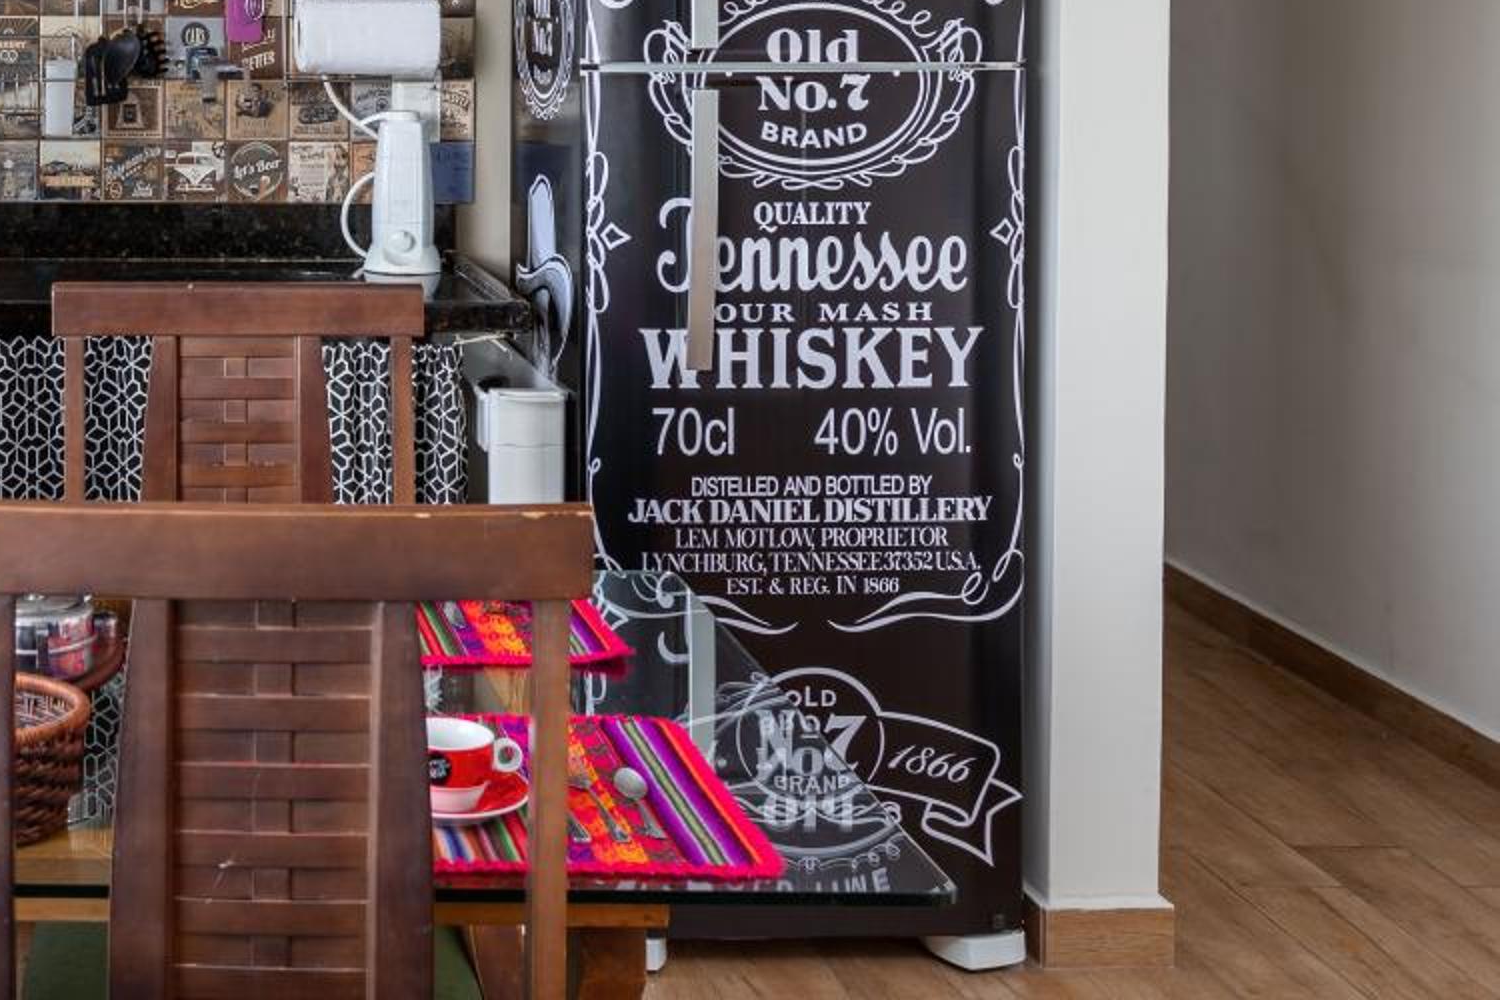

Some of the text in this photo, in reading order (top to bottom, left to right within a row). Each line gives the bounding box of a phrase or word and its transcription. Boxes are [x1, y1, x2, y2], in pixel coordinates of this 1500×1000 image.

[766, 29, 860, 62] Old
[760, 121, 867, 149] BRAND
[754, 202, 871, 232] QUALITY
[656, 197, 967, 293] Tennessee
[714, 302, 932, 322] OUR MASH
[639, 326, 986, 389] WHISKEY
[652, 407, 971, 456] 70cl 40% Vol.
[783, 476, 821, 496] AND
[825, 475, 904, 495] BOTTLED
[909, 475, 932, 495] BY
[627, 496, 992, 524] JACK DANIEL DISTILLERY
[676, 526, 948, 550] LEM MOTLOW, PROPRIETOR
[642, 551, 767, 575] LYNCHBURG,
[727, 574, 900, 595] EST. & REG. IN 1866
[786, 685, 837, 708] OLD
[888, 744, 976, 783] 1866
[773, 775, 850, 795] BRAND
